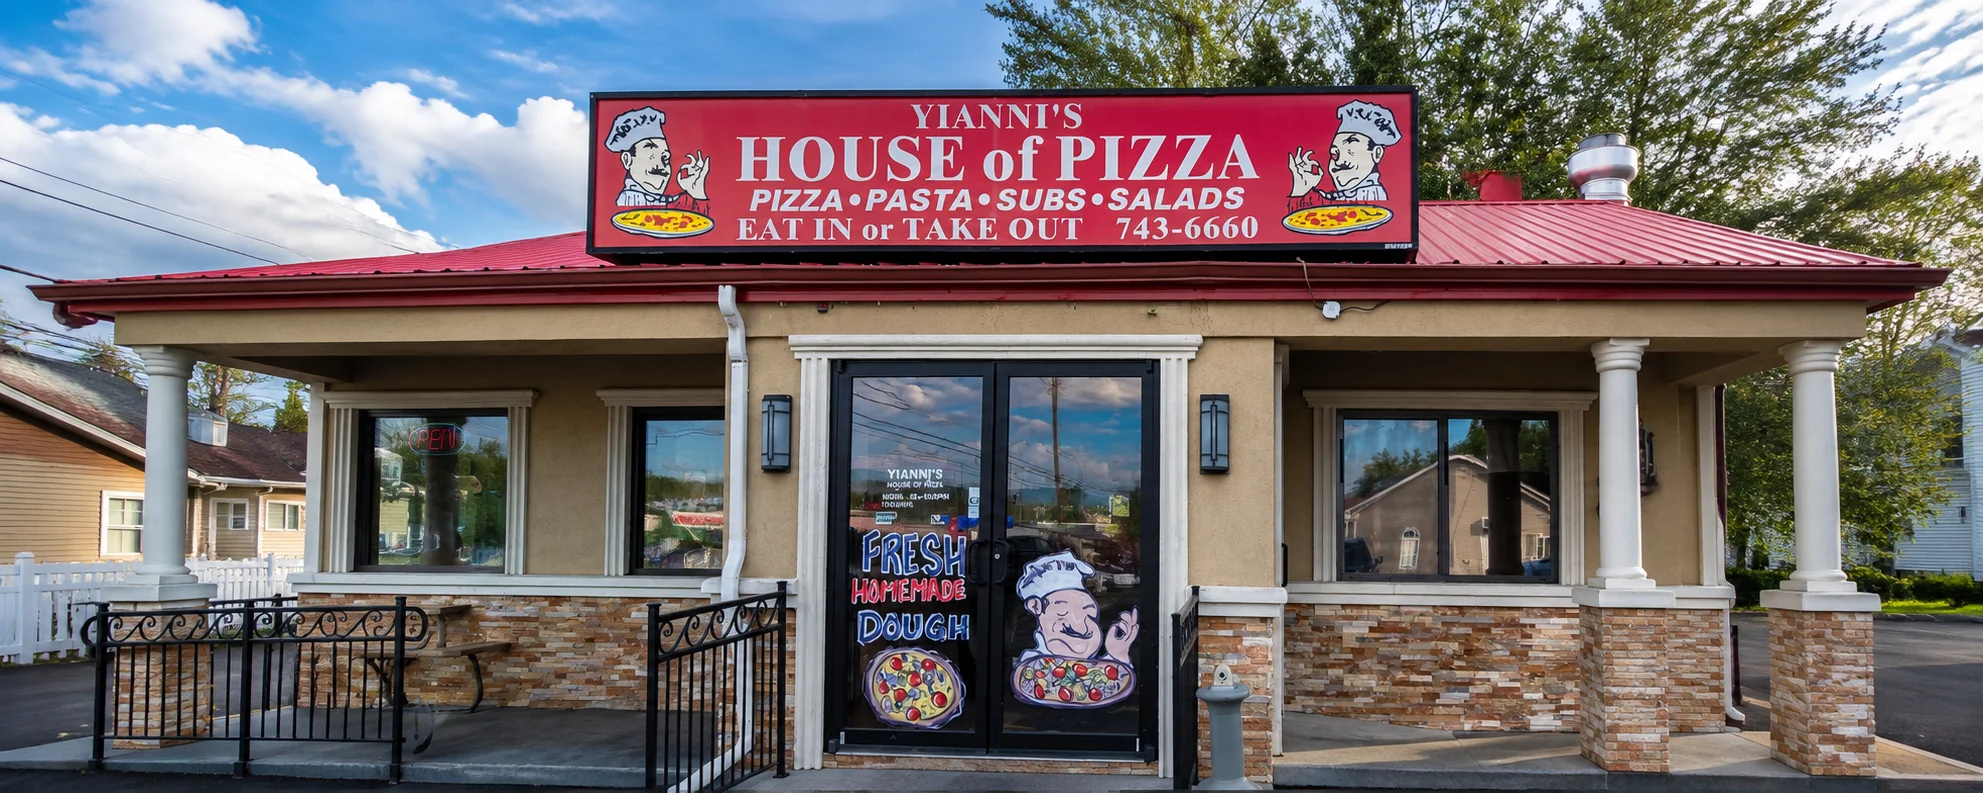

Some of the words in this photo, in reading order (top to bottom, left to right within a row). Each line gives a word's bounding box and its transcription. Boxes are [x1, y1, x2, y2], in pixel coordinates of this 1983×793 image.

[911, 103, 1083, 130] YIANNI'S
[736, 136, 965, 183] HOUSE
[983, 135, 1044, 182] of
[1056, 134, 1261, 181] PIZZA
[736, 217, 804, 241] EAT
[813, 217, 853, 241] IN
[861, 223, 894, 241] or
[903, 217, 998, 241] TAKE
[1008, 217, 1082, 241] OUT
[1116, 215, 1259, 241] 743-6660
[862, 529, 967, 578] FRESH
[851, 578, 967, 605] HOMEMADE
[857, 610, 970, 646] DOUGH
